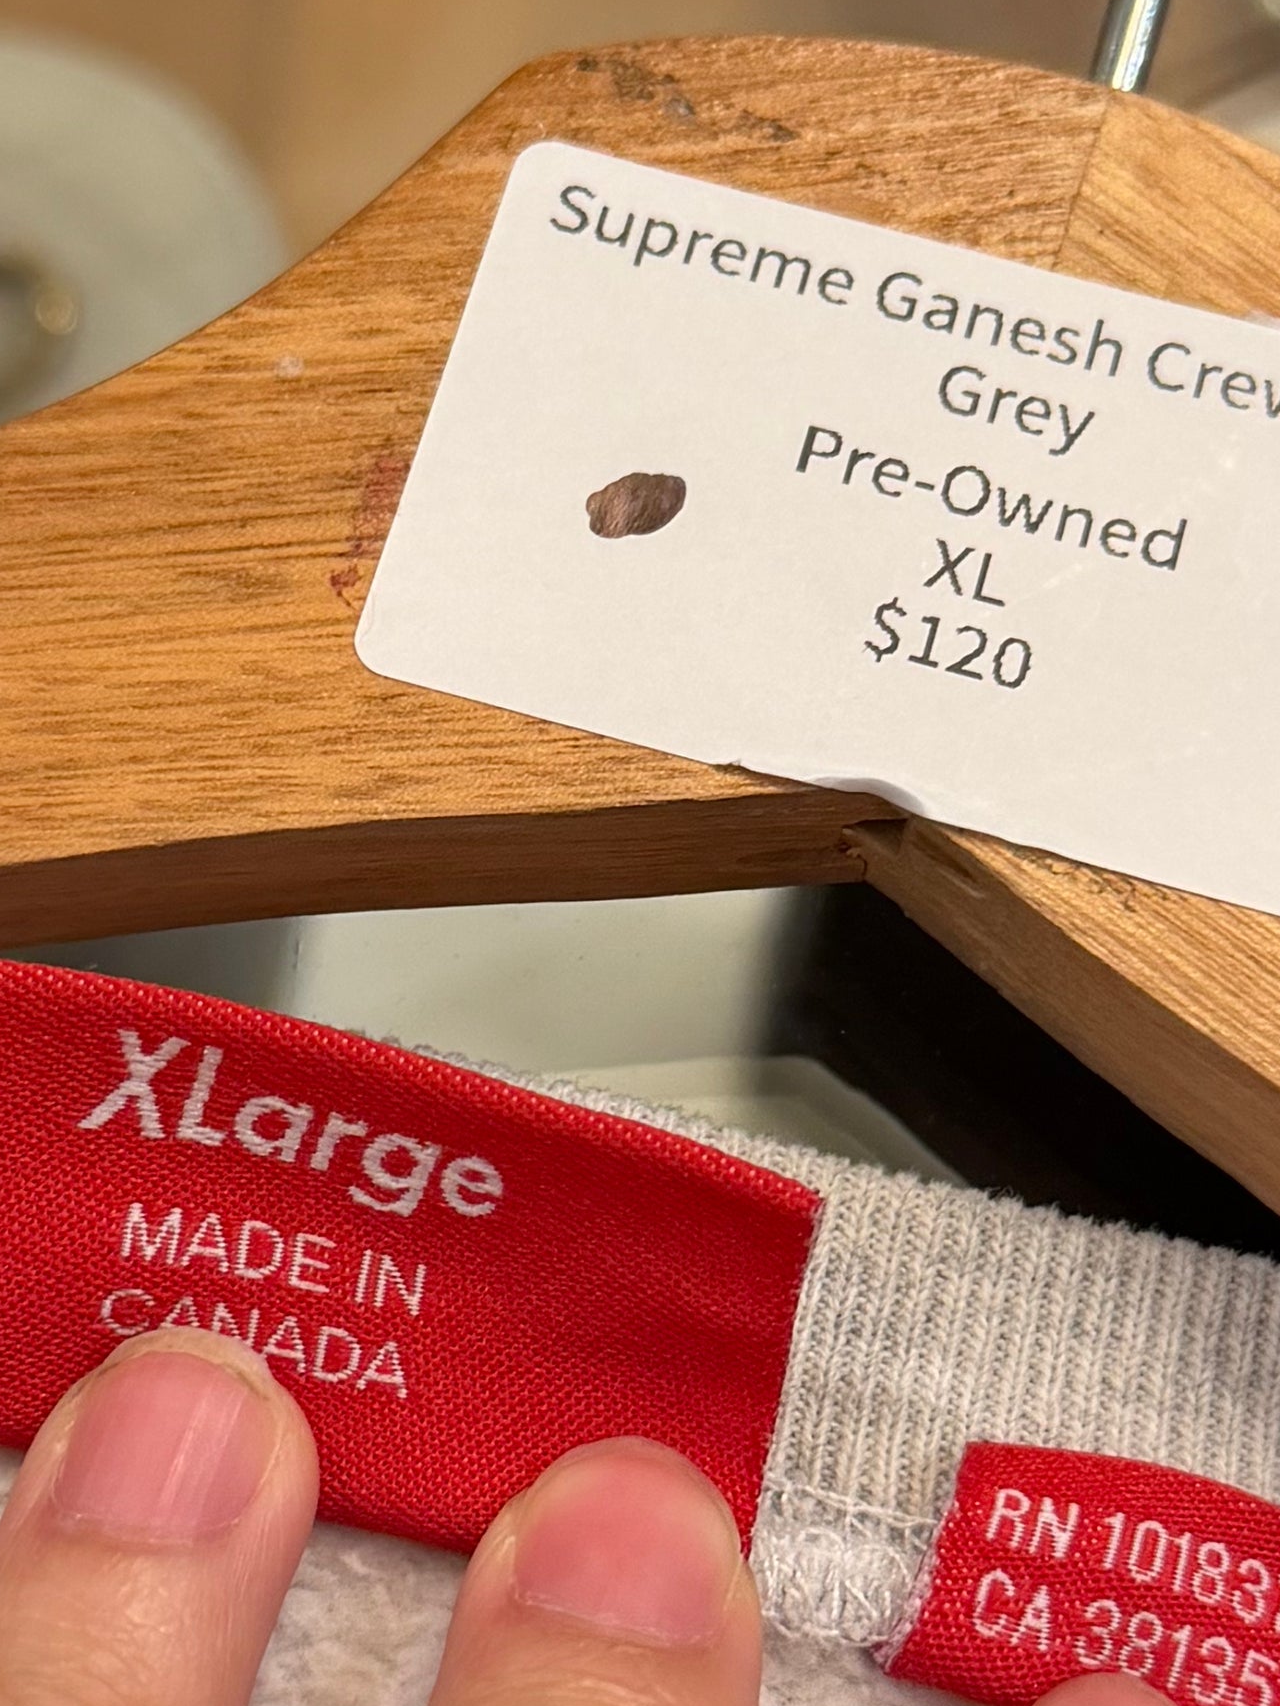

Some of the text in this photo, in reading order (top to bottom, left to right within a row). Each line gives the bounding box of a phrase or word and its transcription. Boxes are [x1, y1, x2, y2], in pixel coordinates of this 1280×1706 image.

[549, 183, 856, 307] Supreme
[874, 269, 1124, 377] Ganesh
[937, 365, 1095, 456] Grey
[795, 426, 1188, 571] Pre-Owned
[924, 540, 1007, 606] XL
[863, 598, 1032, 690] $120
[78, 1028, 503, 1218] XLarge
[120, 1202, 426, 1316] MADE IN
[985, 1488, 1080, 1559] RN
[971, 1568, 1051, 1652] CA
